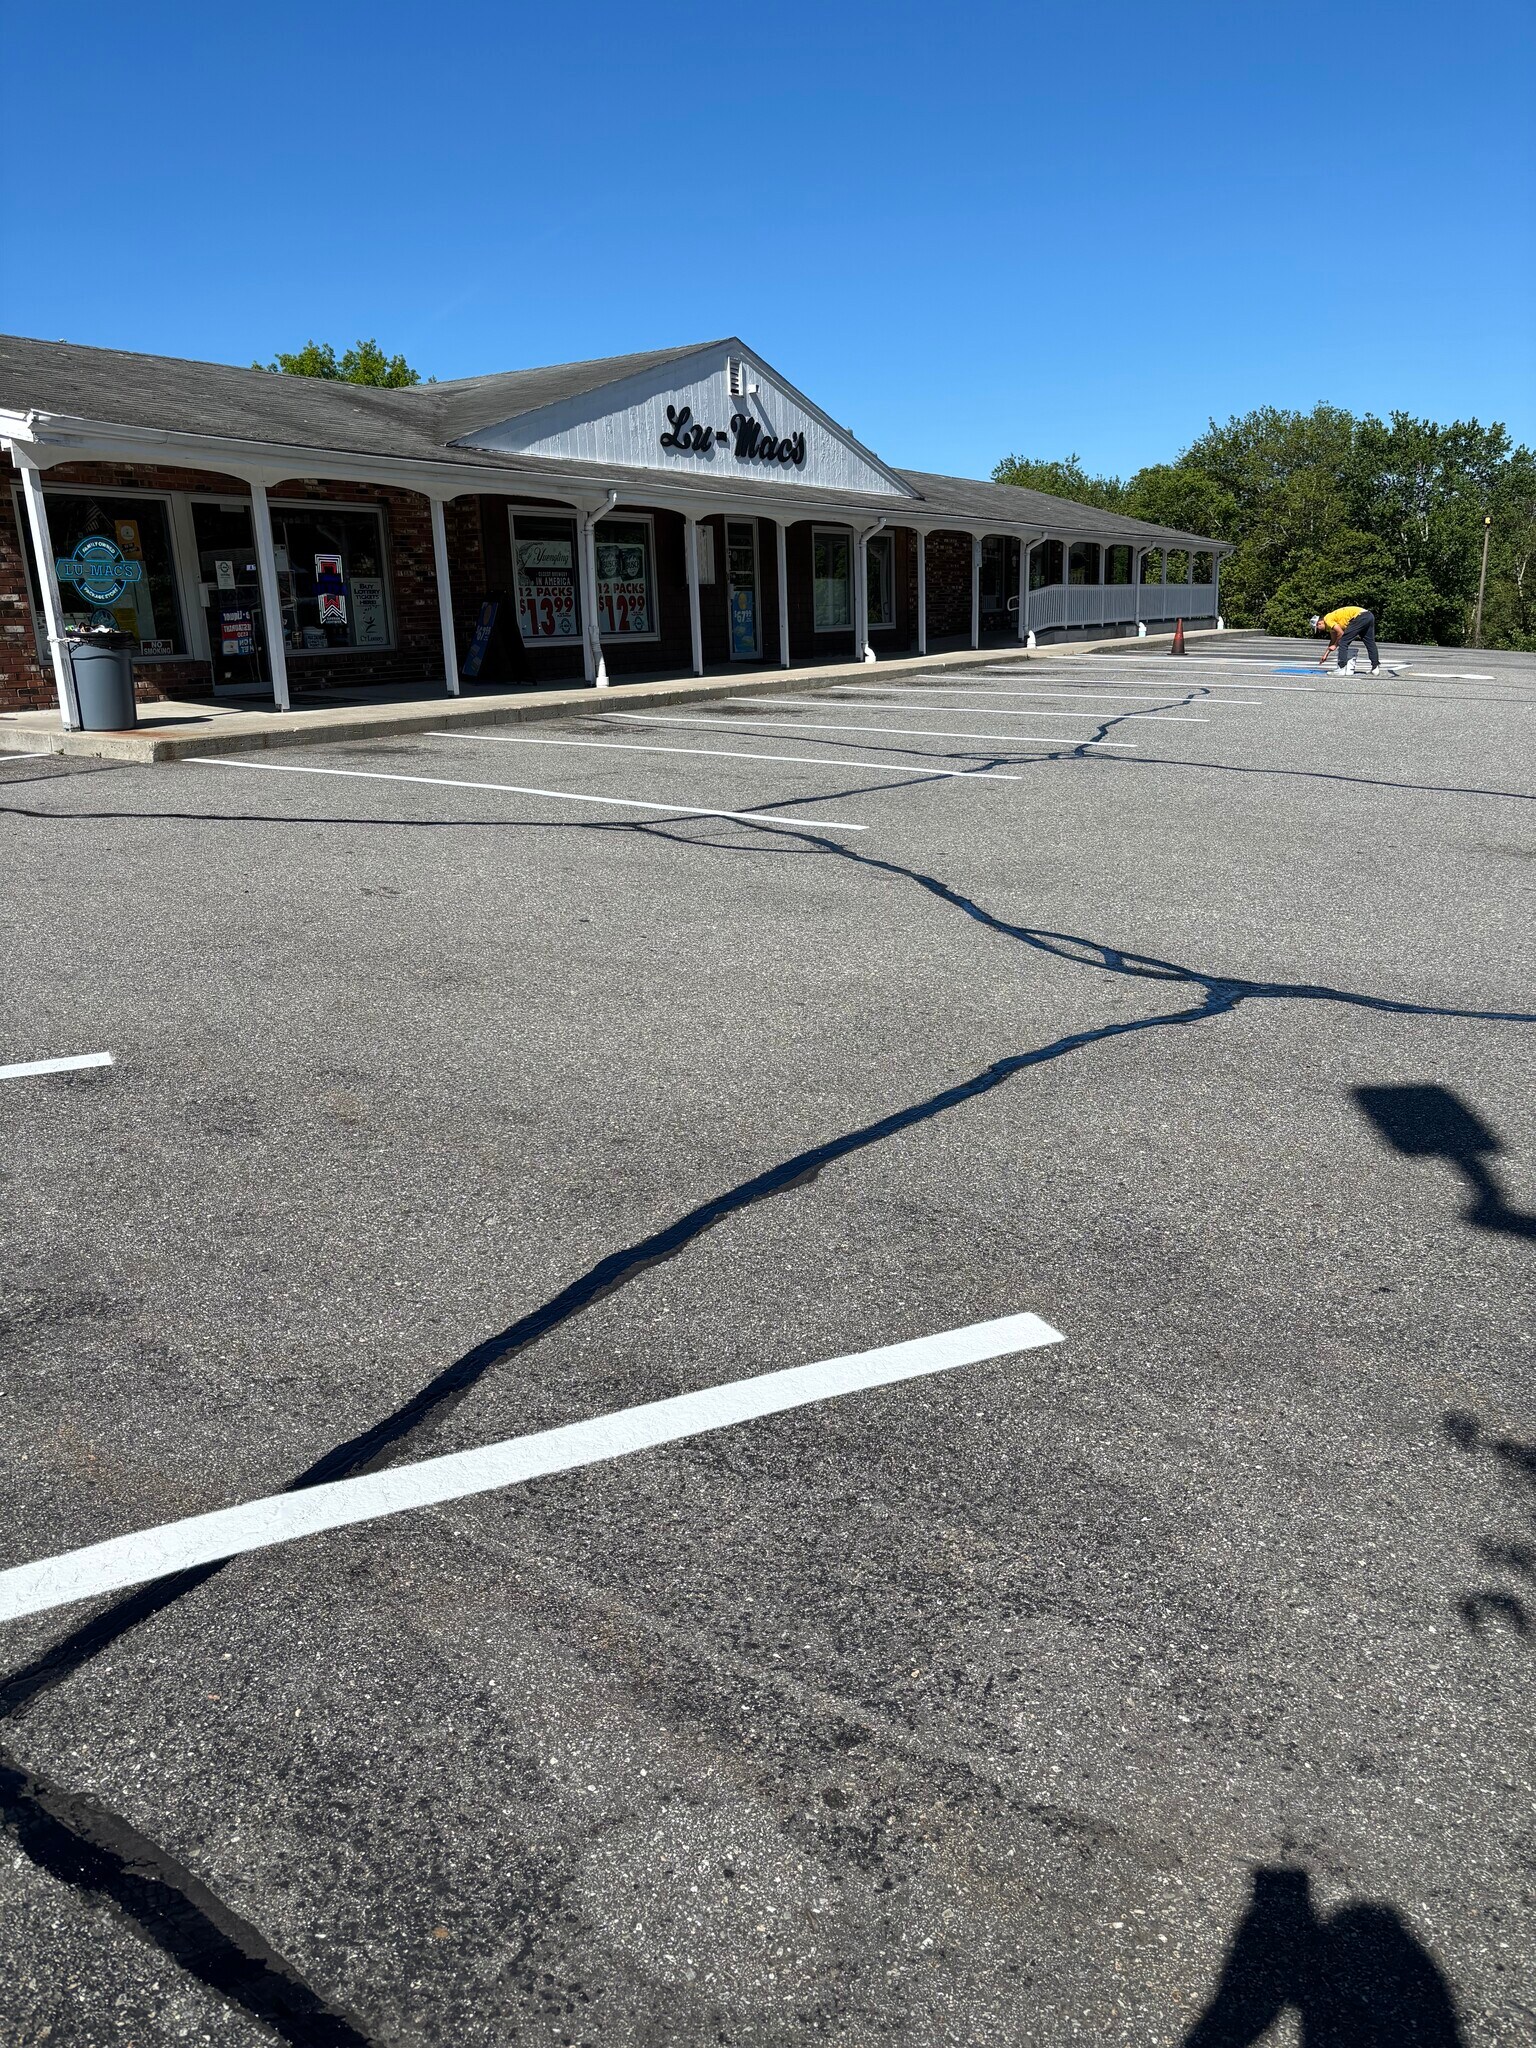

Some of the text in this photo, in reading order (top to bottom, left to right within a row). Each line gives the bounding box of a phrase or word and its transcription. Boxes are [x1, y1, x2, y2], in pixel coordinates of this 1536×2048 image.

[82, 541, 98, 553] FAMILY
[98, 541, 116, 554] OWNED
[533, 547, 569, 564] Yuengling
[544, 577, 572, 586] AMERICA
[518, 587, 573, 597] 12 PACKS
[597, 583, 645, 594] 12 PACKS
[143, 647, 171, 655] SMOKING
